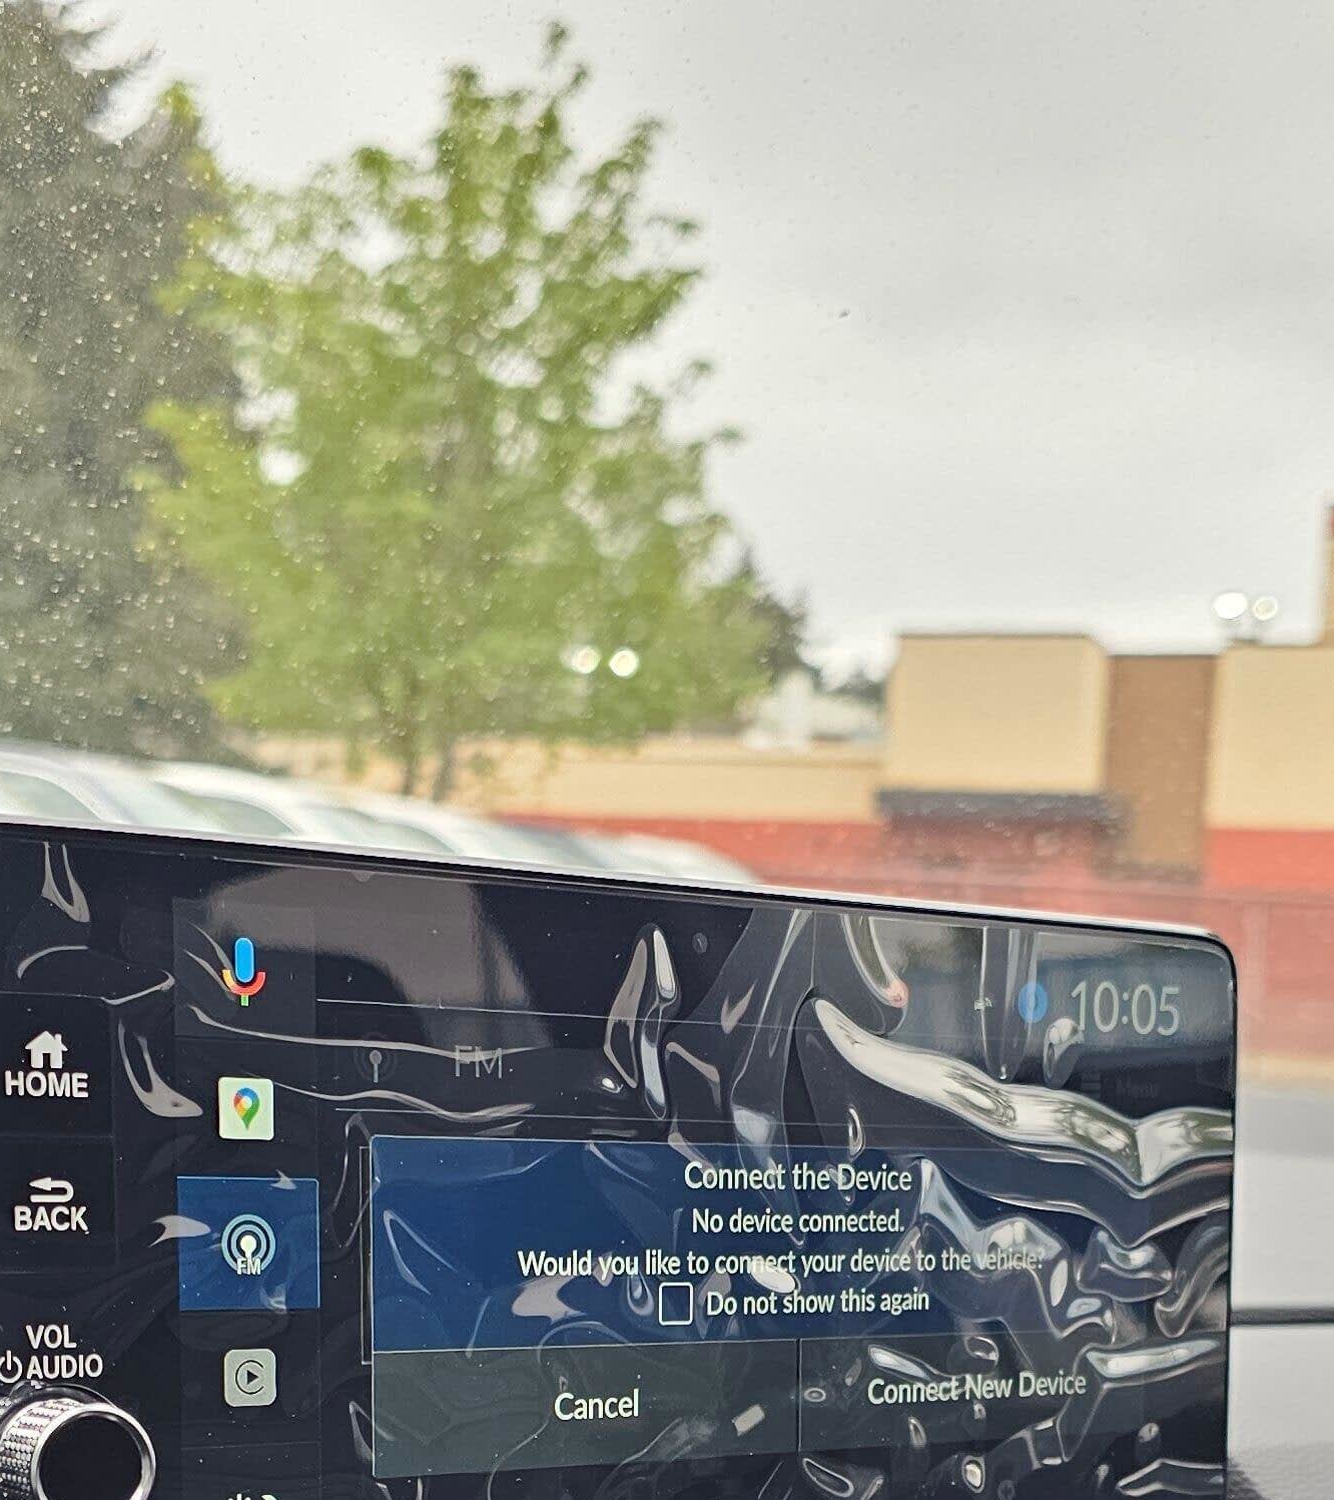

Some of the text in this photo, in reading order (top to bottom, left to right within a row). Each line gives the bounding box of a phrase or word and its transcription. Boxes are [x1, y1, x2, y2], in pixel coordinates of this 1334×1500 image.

[1070, 978, 1181, 1037] 10:05
[453, 1044, 504, 1080] FM
[4, 1069, 90, 1098] HOME
[684, 1161, 913, 1191] Connect the Device
[13, 1205, 89, 1232] BACK
[692, 1207, 906, 1234] No device connected.
[236, 1256, 262, 1276] FM
[517, 1249, 592, 1277] Would
[598, 1254, 639, 1281] you
[645, 1249, 681, 1276] like
[686, 1251, 710, 1275] to
[714, 1250, 796, 1275] connect
[801, 1254, 846, 1278] your
[850, 1247, 911, 1273] device
[917, 1250, 936, 1272] to
[941, 1246, 971, 1272] the
[707, 1288, 930, 1316] Do not show this again
[25, 1324, 78, 1350] VOL
[26, 1352, 104, 1381] AUDIO
[867, 1368, 1087, 1405] Connect New Device
[554, 1388, 640, 1421] Cancel
